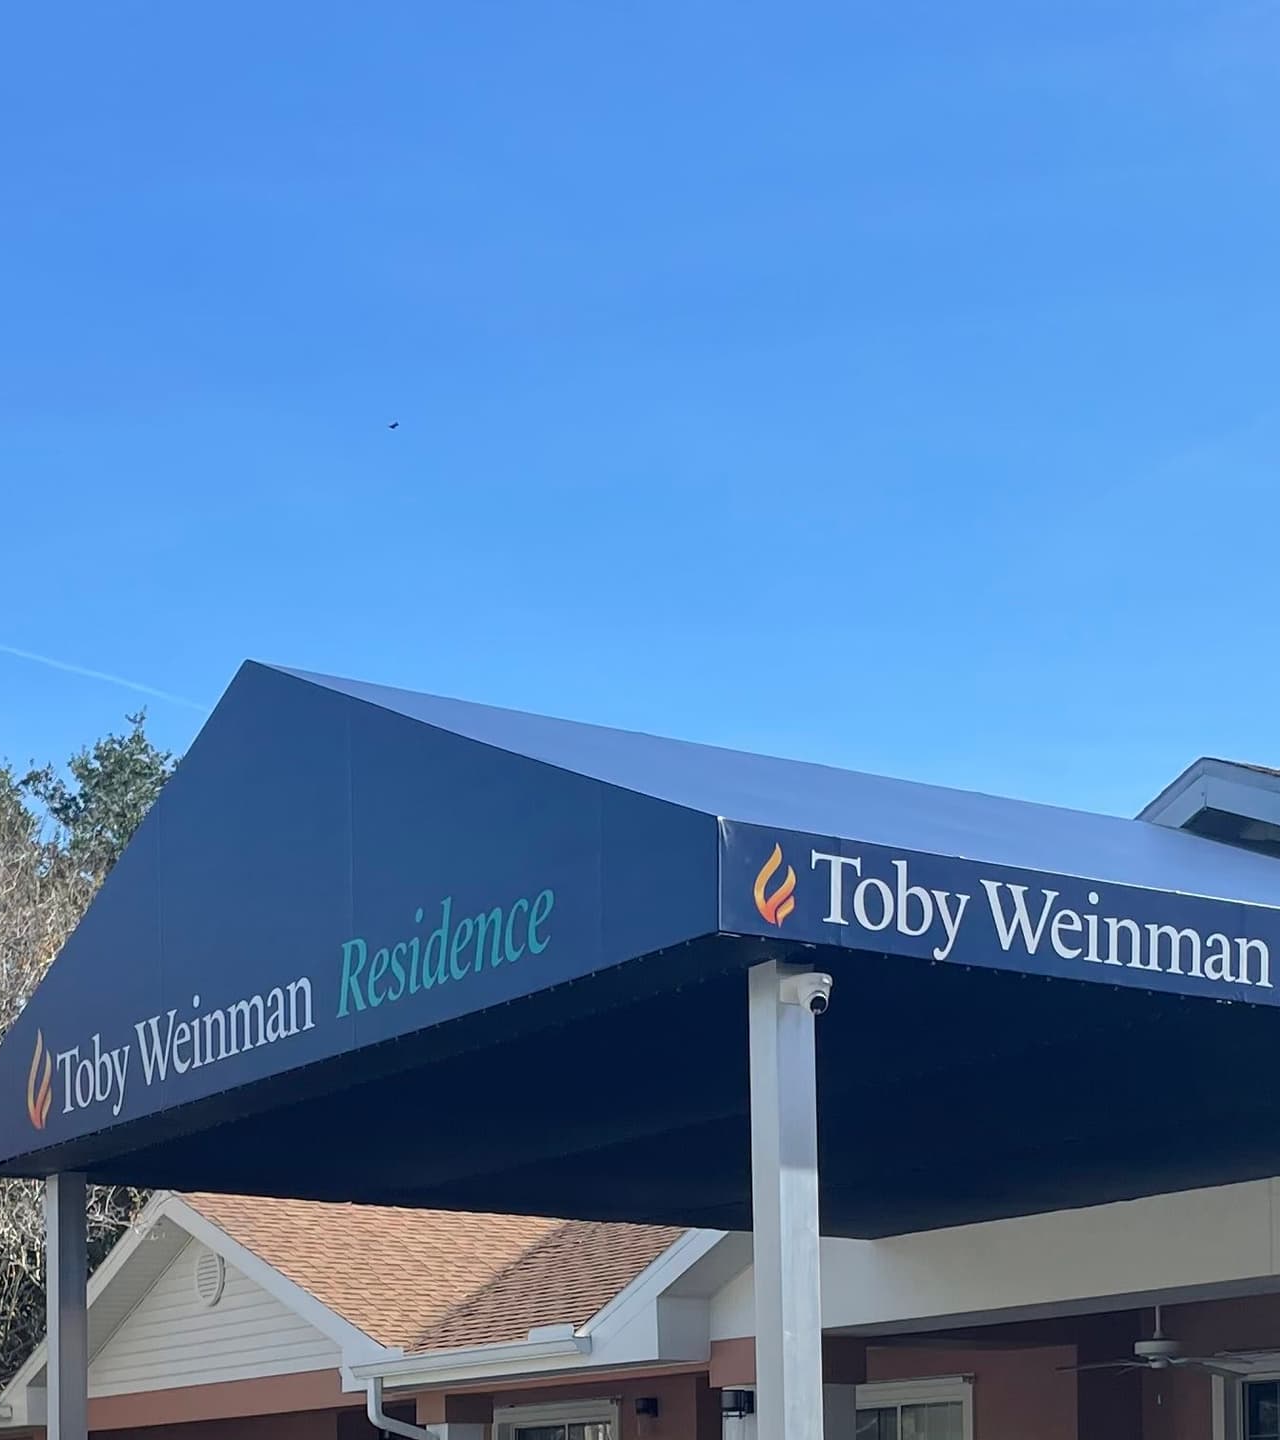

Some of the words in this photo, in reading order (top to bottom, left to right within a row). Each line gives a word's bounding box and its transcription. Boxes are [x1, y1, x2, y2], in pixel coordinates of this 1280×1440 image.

[56, 1032, 130, 1116] Toby
[134, 975, 316, 1086] Weinman
[336, 889, 557, 1019] Residence
[811, 848, 970, 962] Toby
[978, 878, 1273, 989] Weinman
